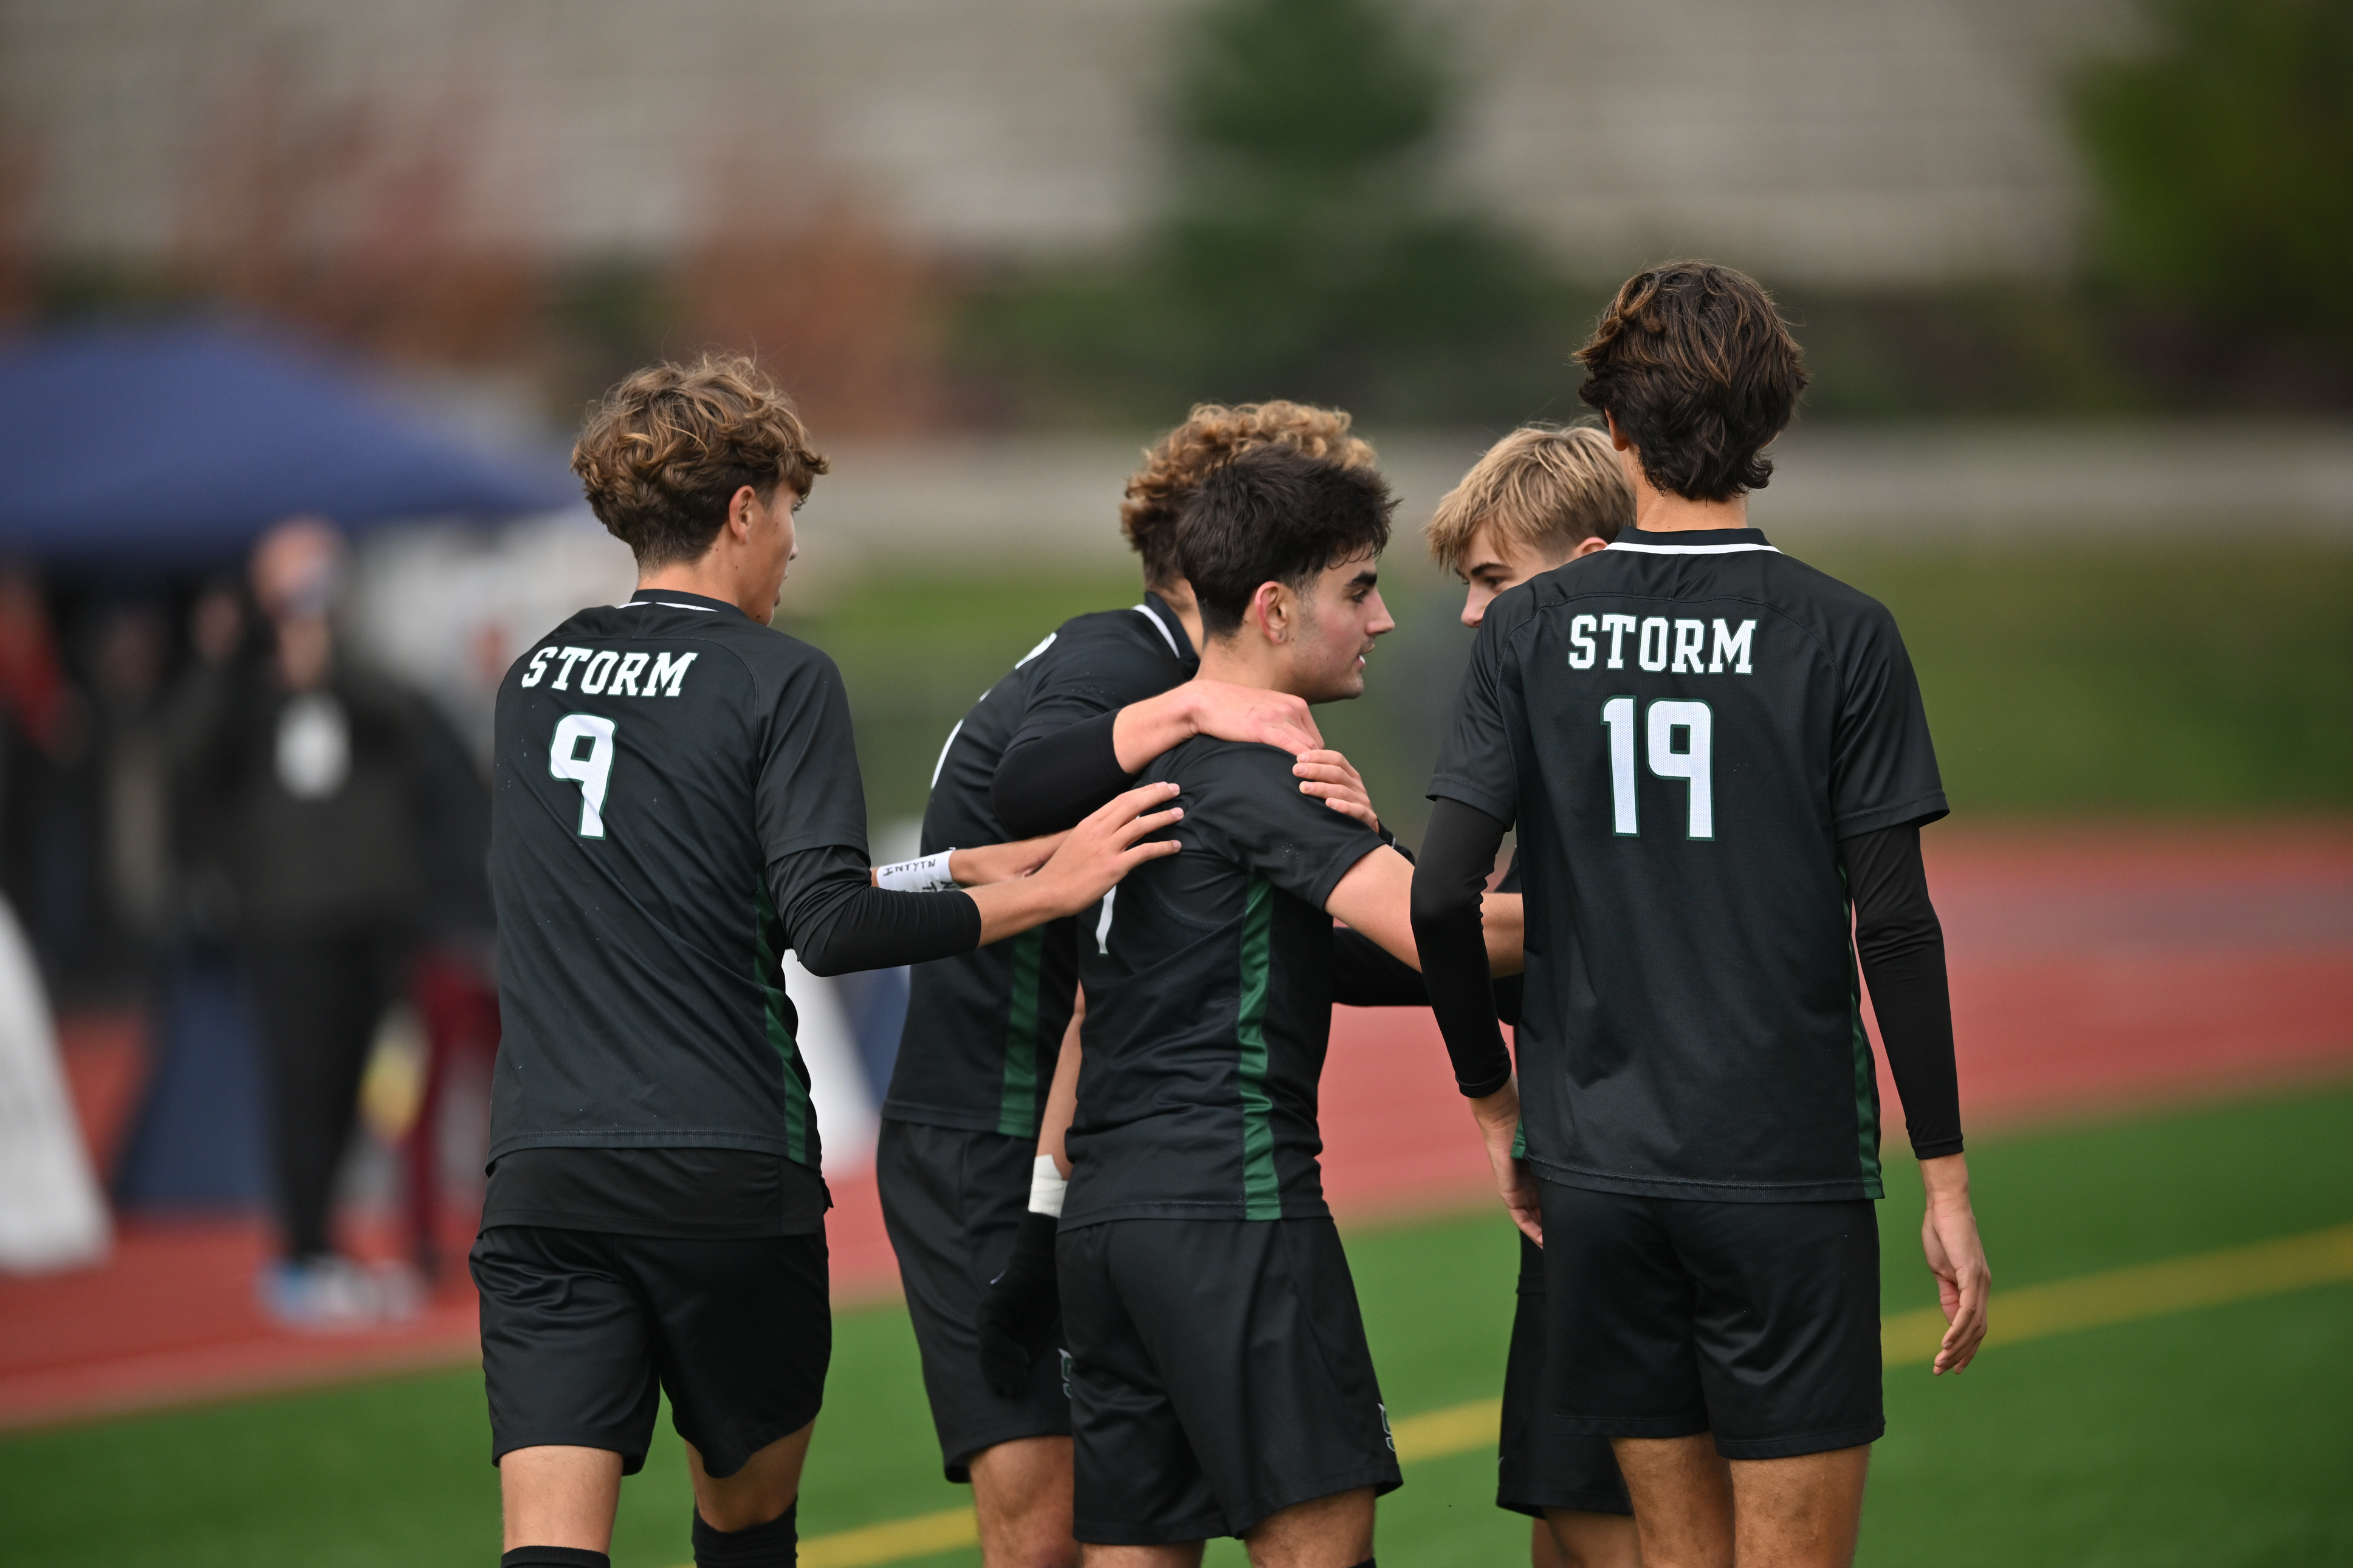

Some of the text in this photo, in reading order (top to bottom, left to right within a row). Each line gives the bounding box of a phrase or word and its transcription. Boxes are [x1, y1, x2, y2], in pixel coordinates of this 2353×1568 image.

[521, 645, 699, 698] STORM
[1567, 612, 1758, 676] STORM
[549, 711, 619, 840] 9
[1600, 694, 1716, 841] 19
